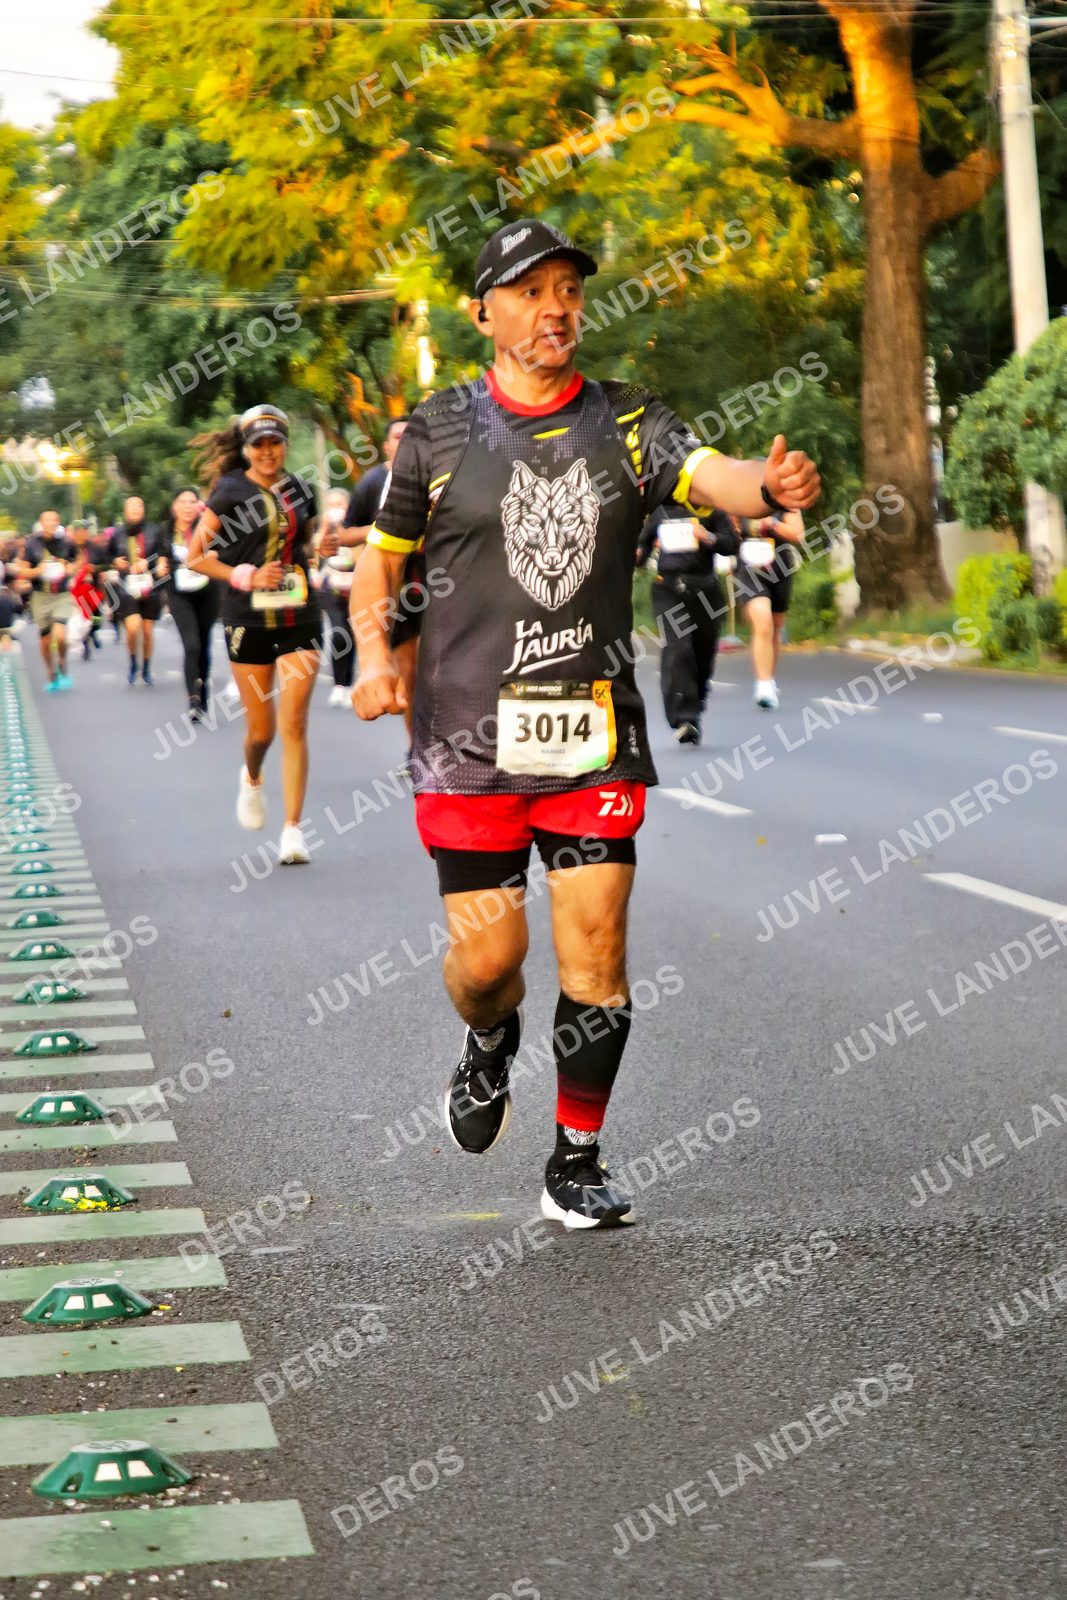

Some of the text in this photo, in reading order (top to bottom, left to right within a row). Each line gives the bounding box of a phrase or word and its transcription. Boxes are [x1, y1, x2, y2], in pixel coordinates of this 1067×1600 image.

[515, 619, 543, 639] LA
[502, 617, 593, 675] JAURÍA
[515, 712, 592, 743] 3014
